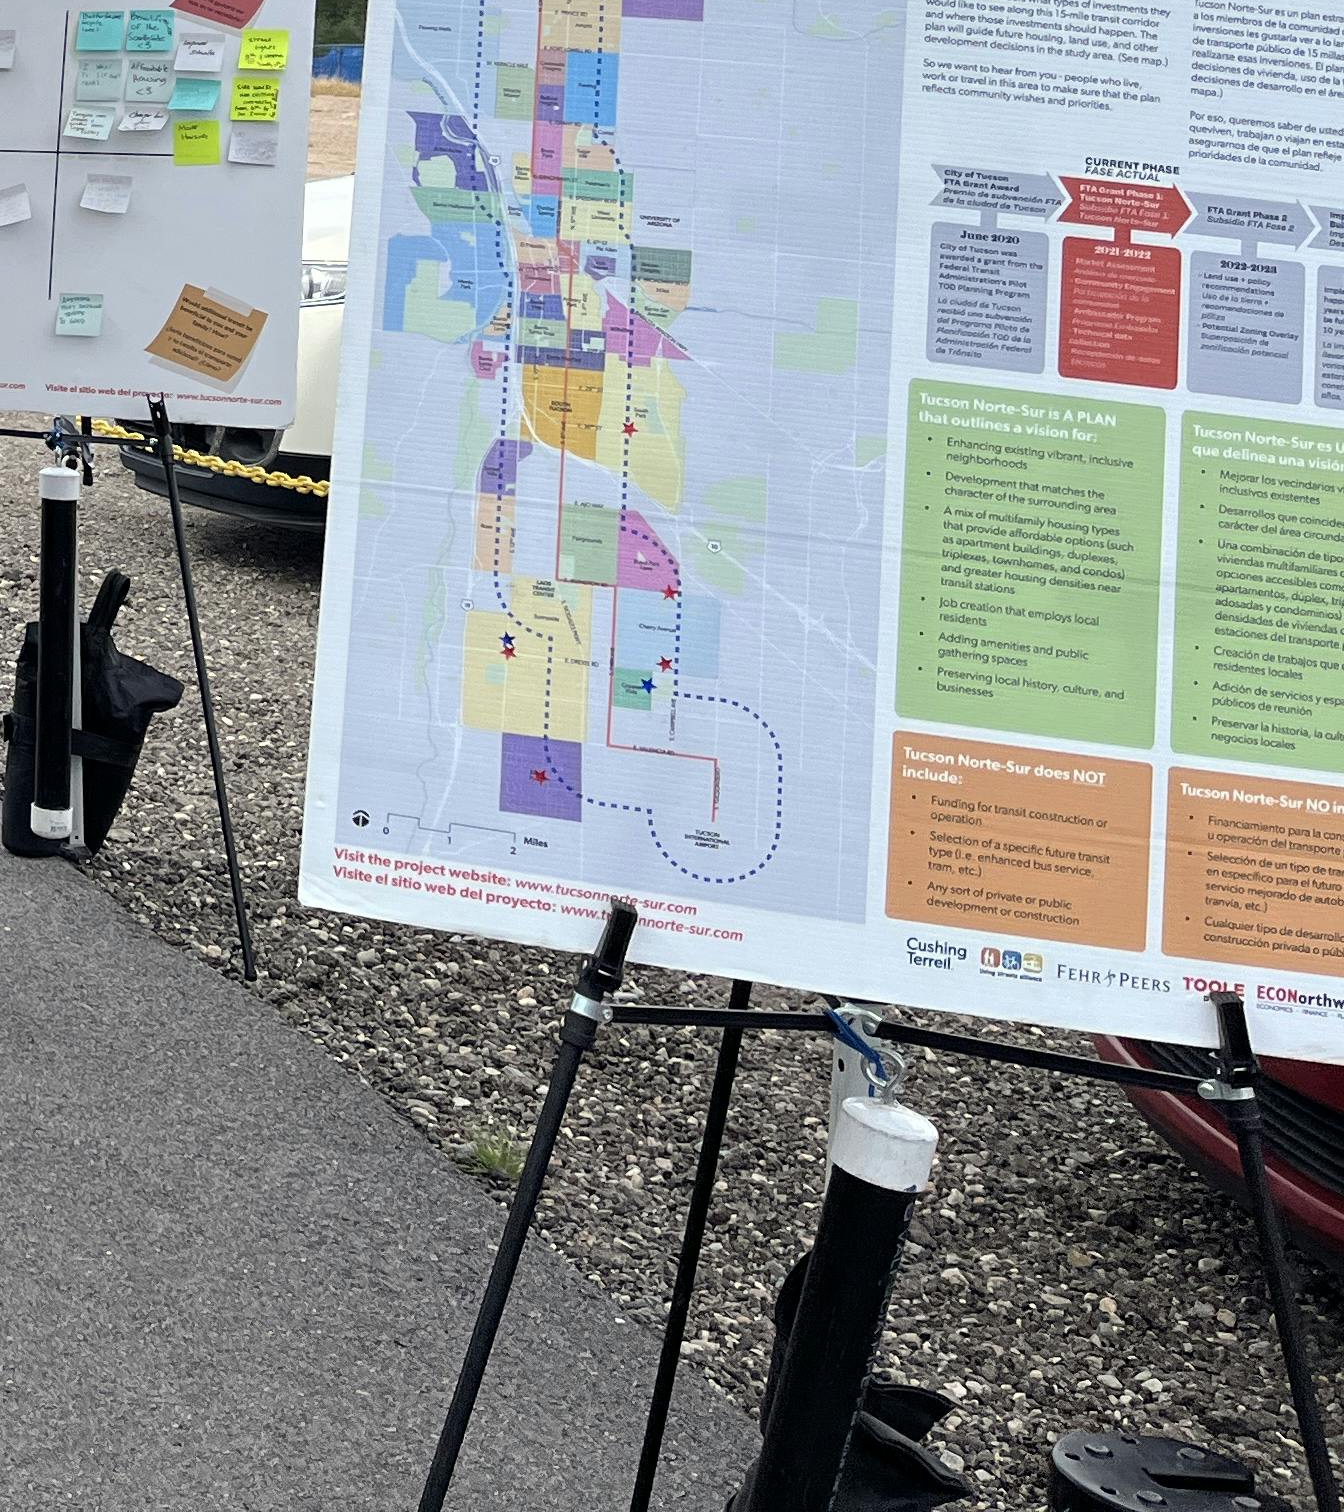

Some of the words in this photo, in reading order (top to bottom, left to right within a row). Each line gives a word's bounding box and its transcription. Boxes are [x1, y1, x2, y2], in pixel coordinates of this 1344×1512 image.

[1084, 156, 1139, 169] CURRENT
[1142, 162, 1179, 174] PHASE
[1084, 165, 1113, 176] FASE
[1115, 169, 1160, 182] ACTUAL
[919, 392, 969, 409] Tucson
[973, 398, 1045, 417] Norte-Sur
[1048, 410, 1059, 420] is
[1062, 409, 1073, 421] A
[1076, 410, 1116, 426] PLAN
[902, 746, 954, 764] Tucson
[957, 754, 1031, 774] Norte-Sur
[1033, 764, 1070, 780] does
[1072, 768, 1106, 785] NOT
[902, 764, 962, 784] include:
[930, 794, 975, 812] Funding
[976, 800, 992, 812] for
[994, 804, 1026, 817] transit
[1028, 810, 1094, 825] construction
[1095, 819, 1108, 828] or
[333, 847, 365, 863] Visit
[367, 853, 391, 867] the
[393, 860, 446, 876] project
[448, 868, 510, 886] website:
[906, 936, 967, 960] Cushing
[908, 952, 950, 969] Terrell
[1056, 963, 1100, 983] FEHR
[1119, 972, 1170, 992] PEERS
